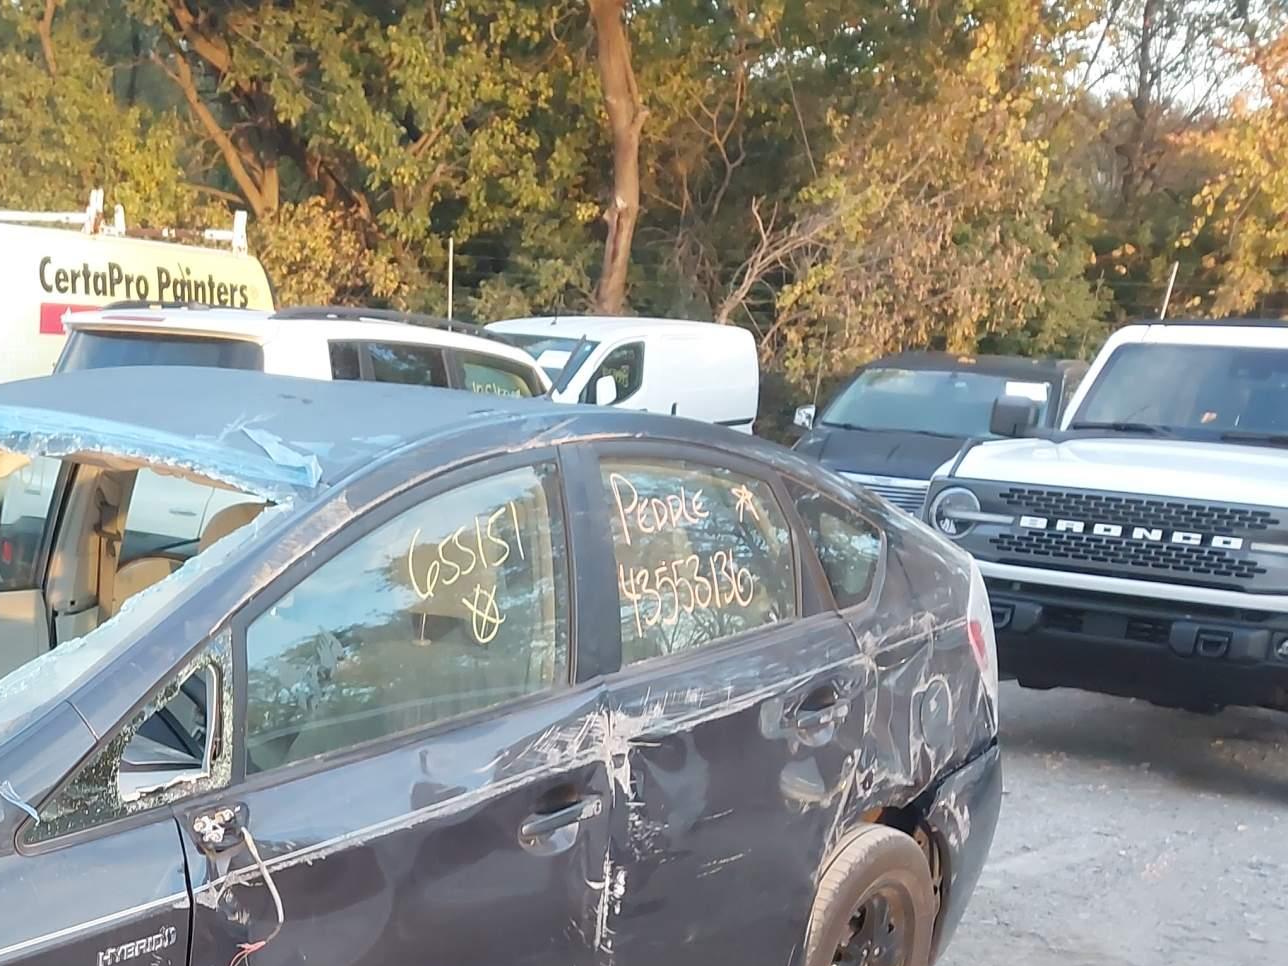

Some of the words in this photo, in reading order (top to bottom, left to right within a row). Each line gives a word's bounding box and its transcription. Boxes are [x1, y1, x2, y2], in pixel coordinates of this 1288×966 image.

[39, 255, 149, 301] CertaPro
[157, 264, 248, 309] Painters
[408, 500, 525, 599] 655151
[1019, 515, 1244, 550] BRONCO
[617, 548, 754, 639] 43553136
